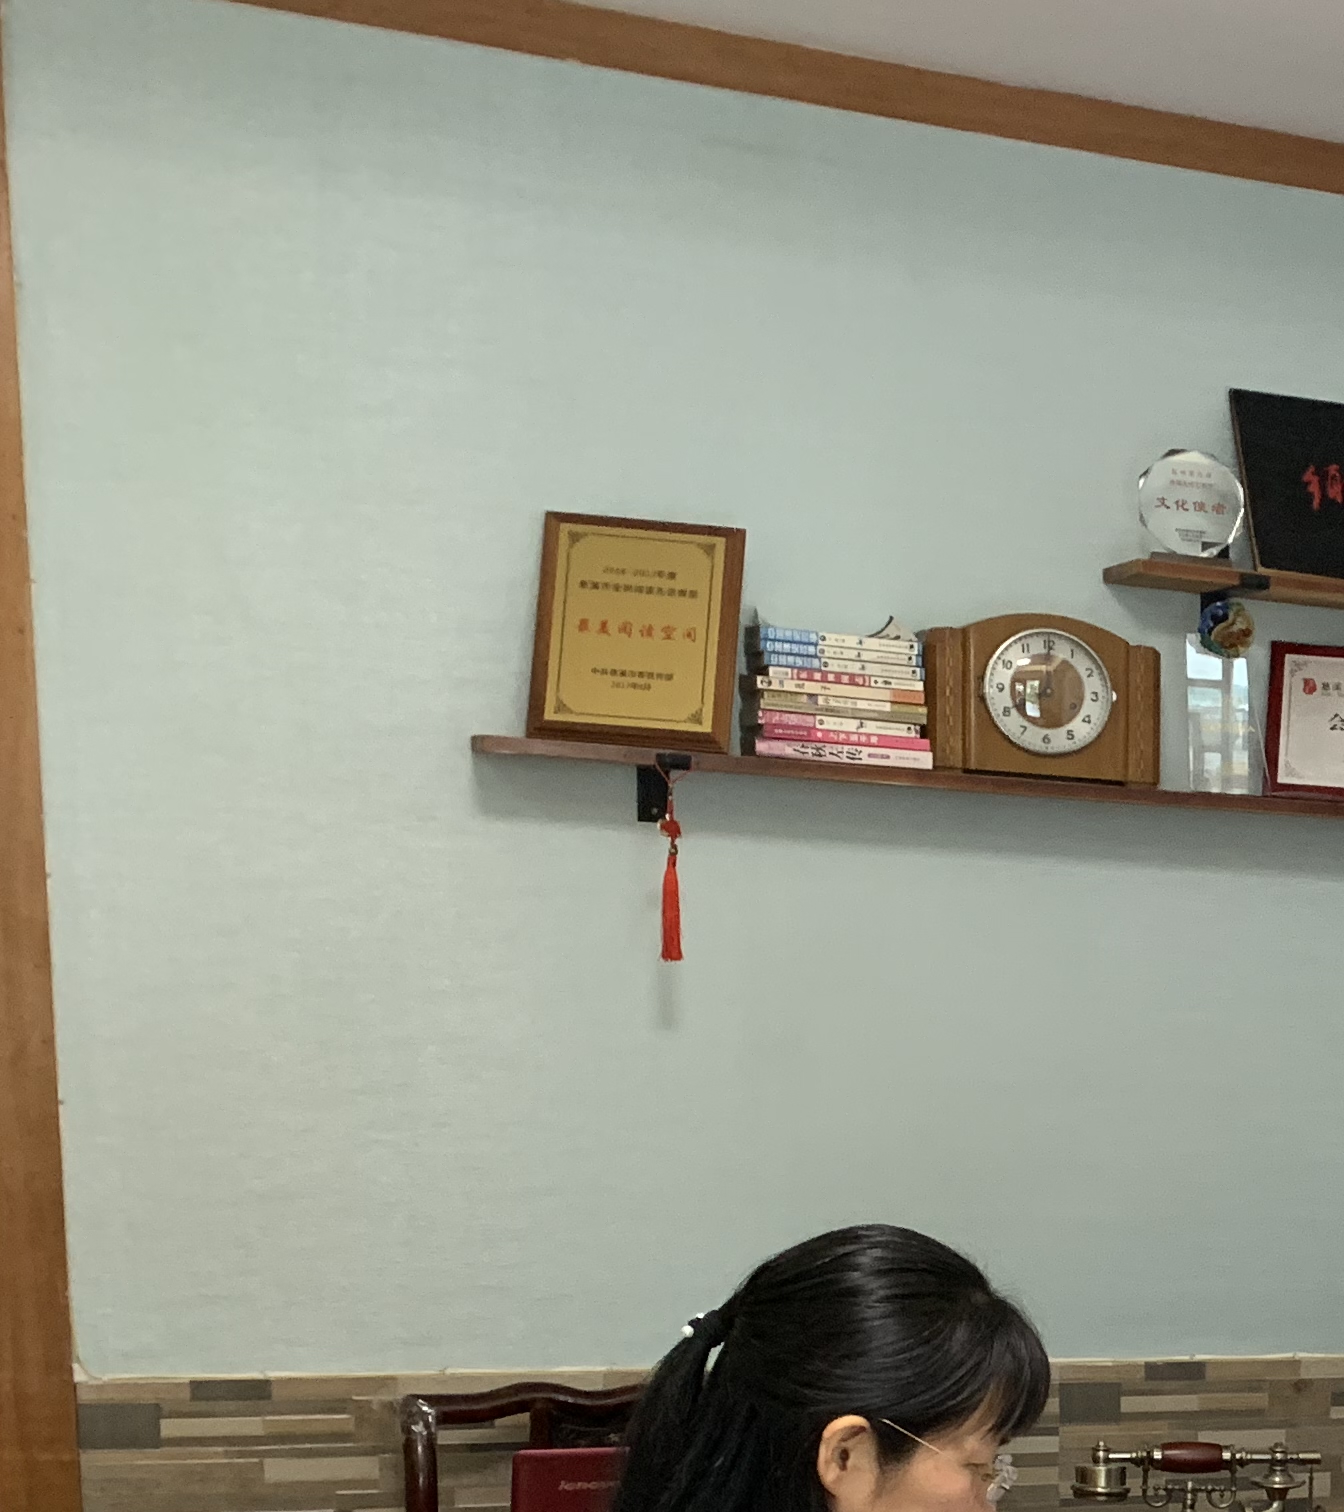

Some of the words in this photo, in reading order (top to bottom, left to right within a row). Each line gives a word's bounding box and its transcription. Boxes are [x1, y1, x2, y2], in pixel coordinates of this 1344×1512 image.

[1021, 643, 1031, 654] 11
[1043, 639, 1056, 651] 12
[1070, 648, 1075, 659] 1
[1001, 659, 1013, 670] 10
[1085, 667, 1094, 678] 2
[995, 682, 1005, 693] 9
[1090, 691, 1099, 702] 3
[1002, 706, 1012, 718] 8
[1081, 714, 1092, 725] 4
[1019, 725, 1028, 736] 7
[1066, 729, 1075, 741] 5
[1042, 734, 1051, 744] 6
